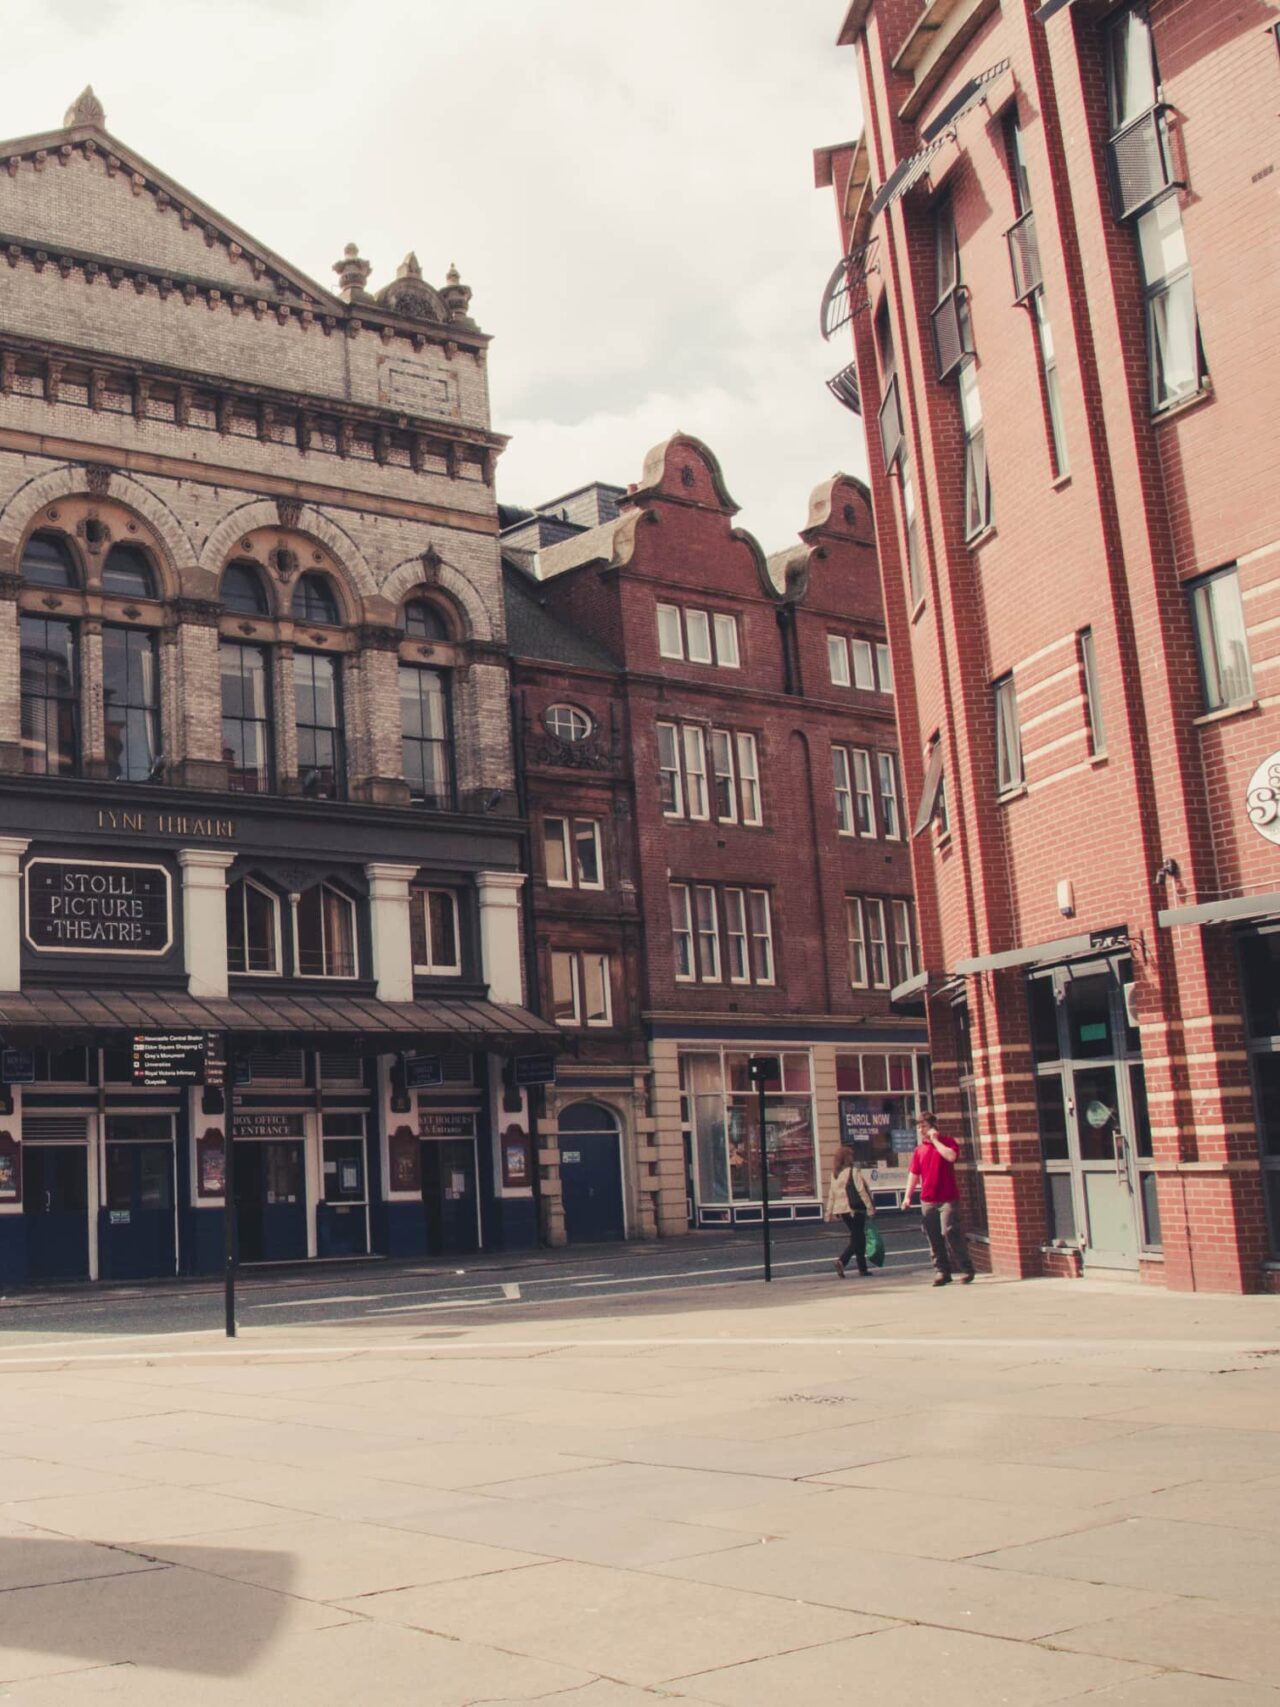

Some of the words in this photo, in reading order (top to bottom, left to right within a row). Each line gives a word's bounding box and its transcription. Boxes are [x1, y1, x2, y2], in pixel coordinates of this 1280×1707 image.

[97, 810, 144, 831] TYNE
[156, 815, 235, 838] THEATRE
[63, 873, 134, 895] STOLL
[50, 896, 144, 918] PICTURE
[53, 919, 143, 941] THEATRE
[175, 1043, 198, 1051] Shopping
[254, 1115, 288, 1125] OFFICE
[846, 1113, 872, 1126] ENROL
[872, 1113, 890, 1125] NOW
[240, 1125, 289, 1135] ENTRANCE
